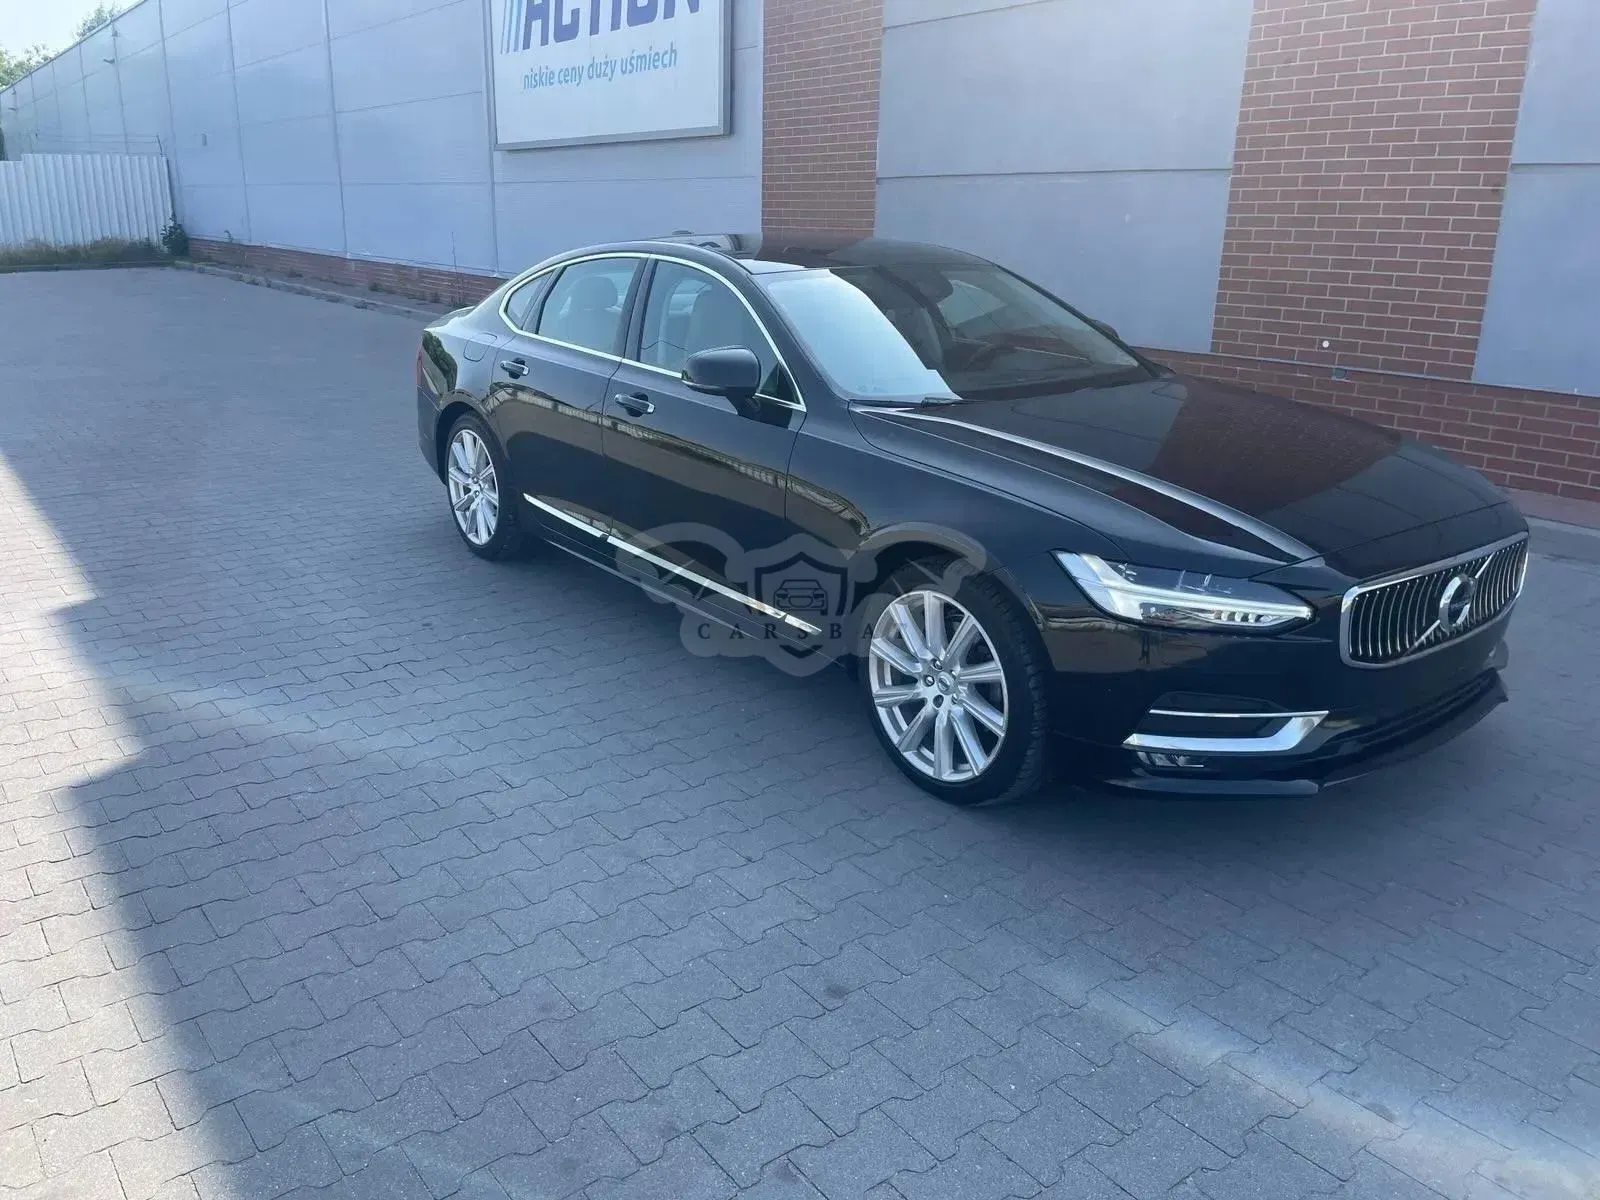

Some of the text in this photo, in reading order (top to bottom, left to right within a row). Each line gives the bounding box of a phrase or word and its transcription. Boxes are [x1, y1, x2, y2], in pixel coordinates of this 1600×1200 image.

[523, 0, 700, 50] ACT
[523, 41, 678, 90] niskie ceny duży uśmiech
